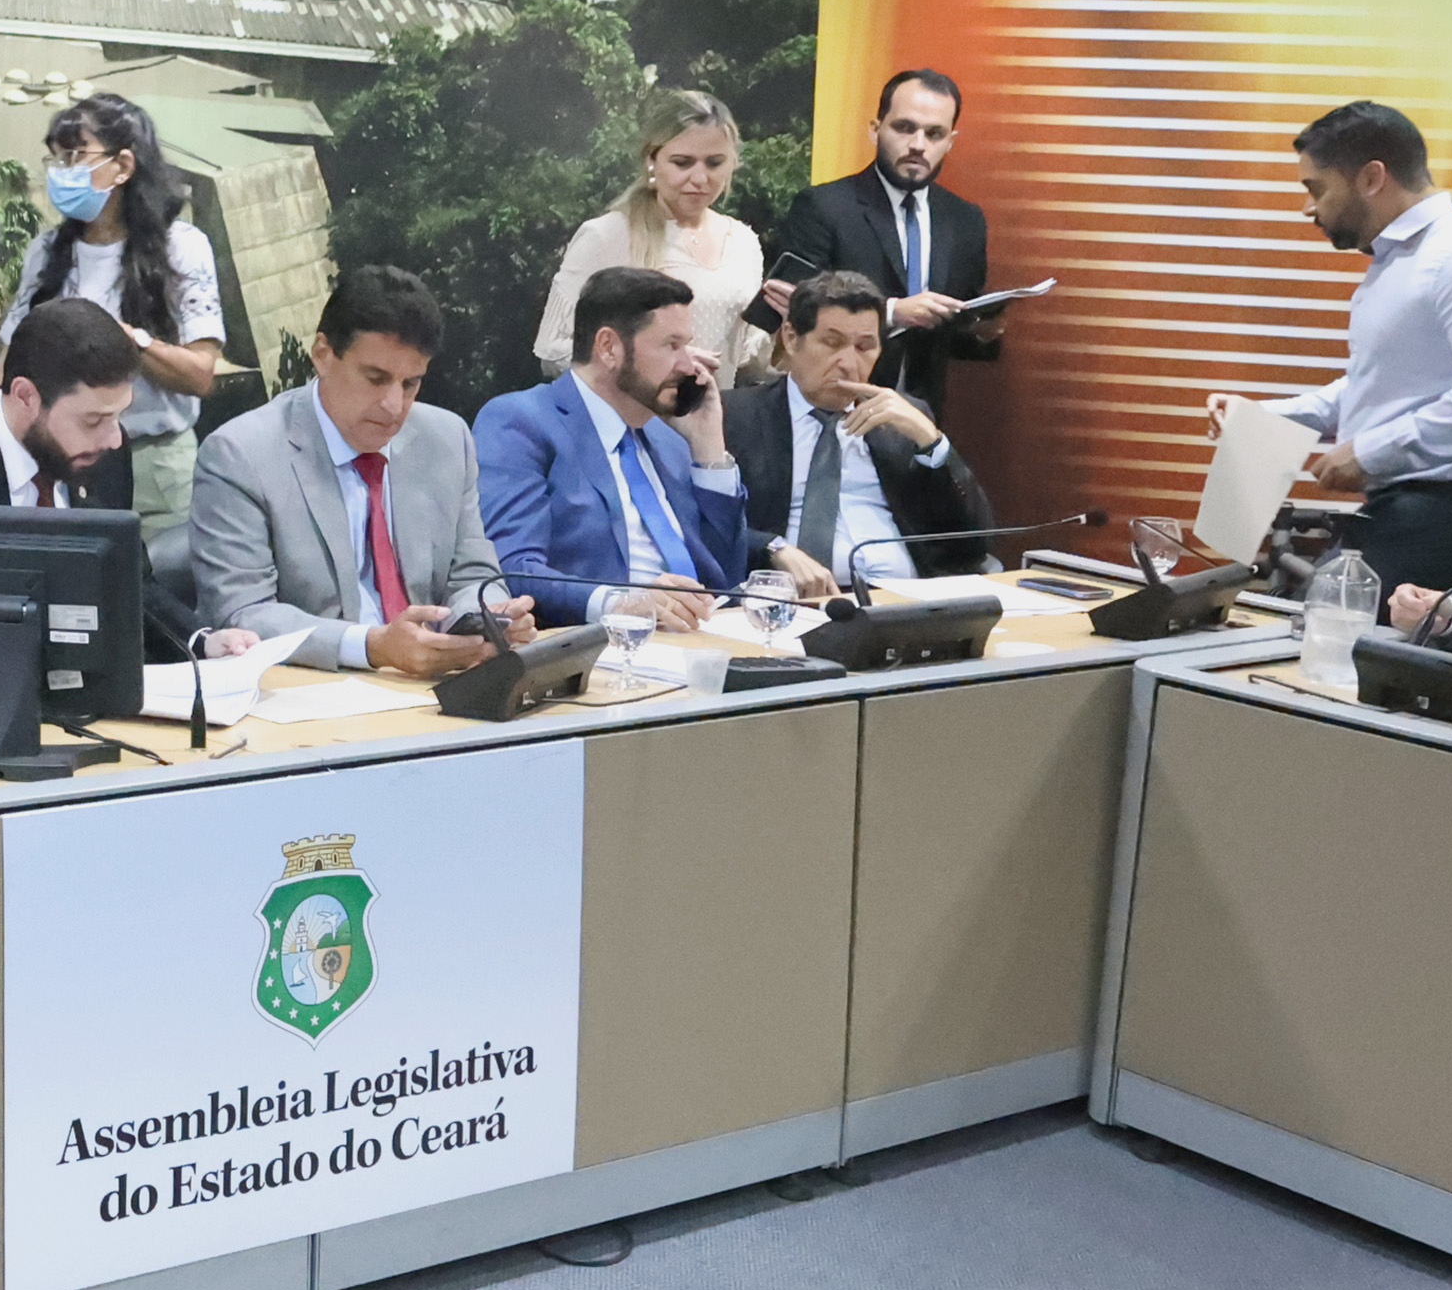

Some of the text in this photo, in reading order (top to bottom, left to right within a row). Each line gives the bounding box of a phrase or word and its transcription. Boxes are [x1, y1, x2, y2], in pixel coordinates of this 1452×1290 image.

[56, 1040, 538, 1165] Assembleia Legislativa
[98, 1095, 509, 1223] do Estado do Ceará
